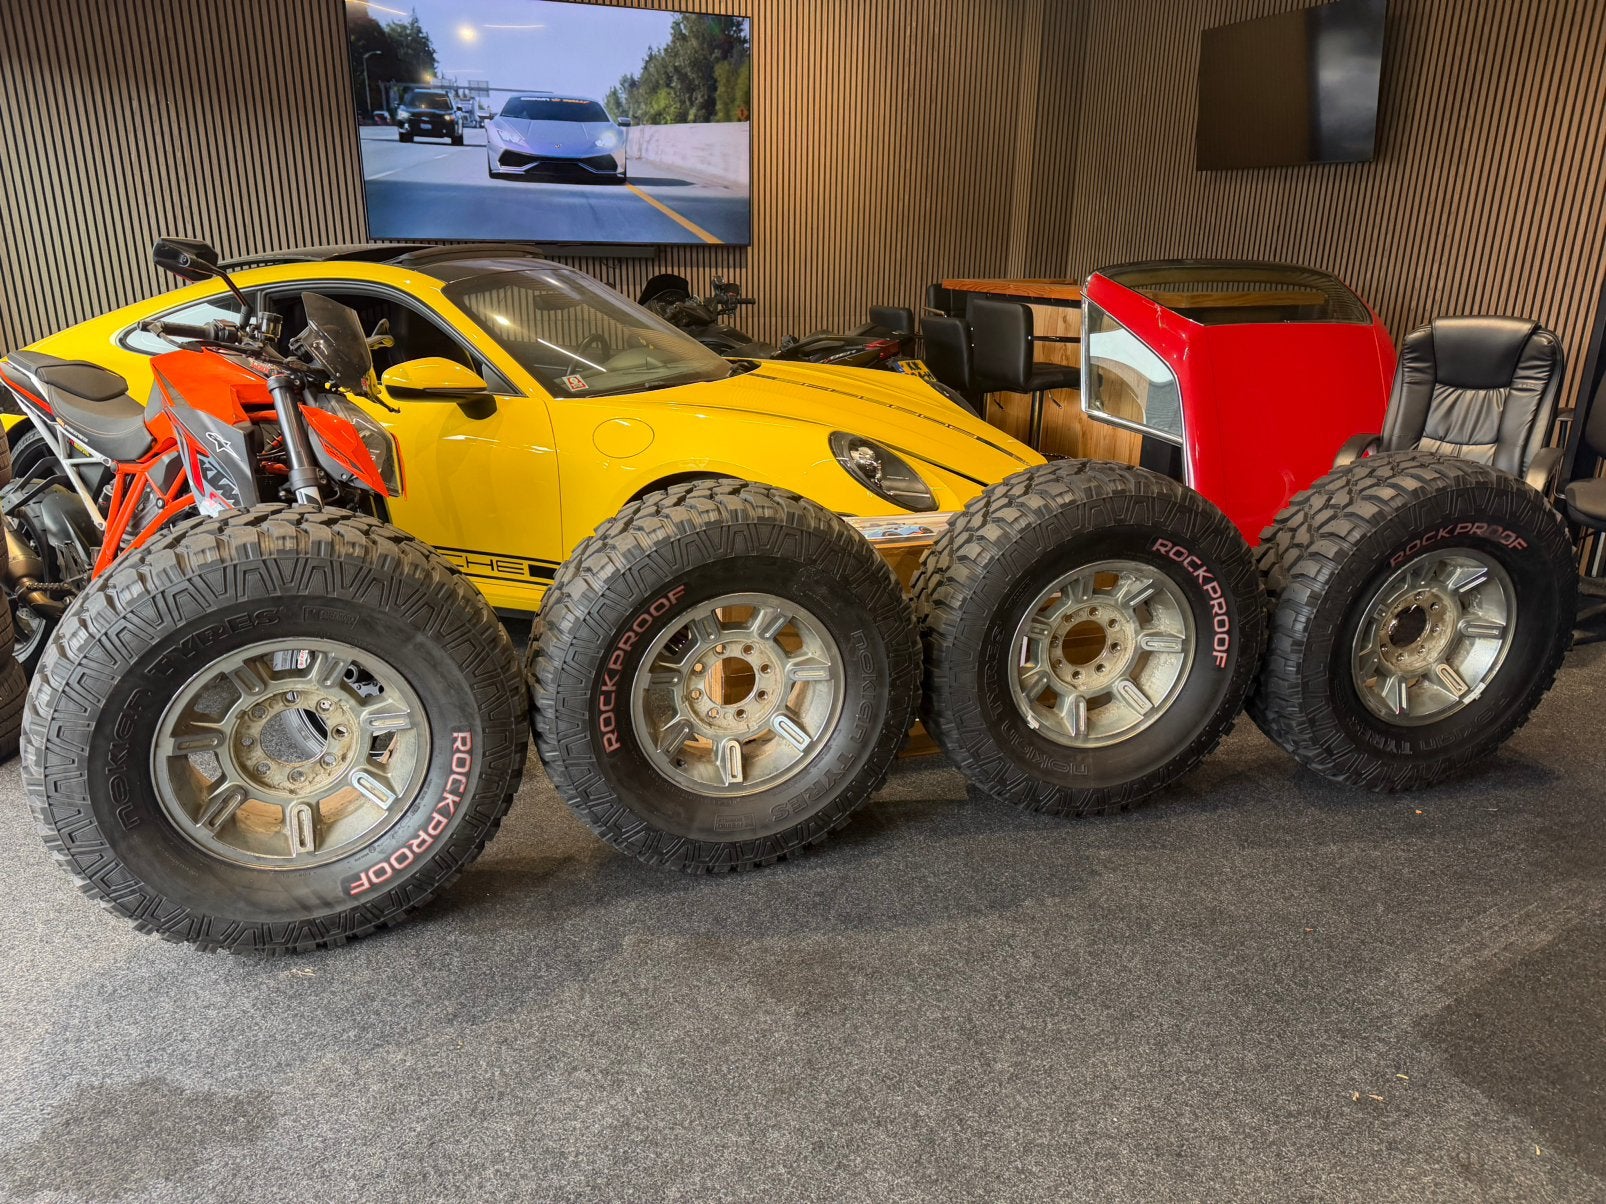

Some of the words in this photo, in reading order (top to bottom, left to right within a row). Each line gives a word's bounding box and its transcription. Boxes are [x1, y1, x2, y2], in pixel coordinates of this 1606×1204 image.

[200, 459, 243, 507] KTM
[1390, 522, 1528, 568] ROCKPROOF
[1152, 538, 1230, 668] ROCKPROOF
[144, 607, 282, 677] TYRES
[600, 585, 685, 753] ROCKPROOF
[349, 730, 473, 896] ROCKPROOF
[770, 752, 856, 821] TYRES
